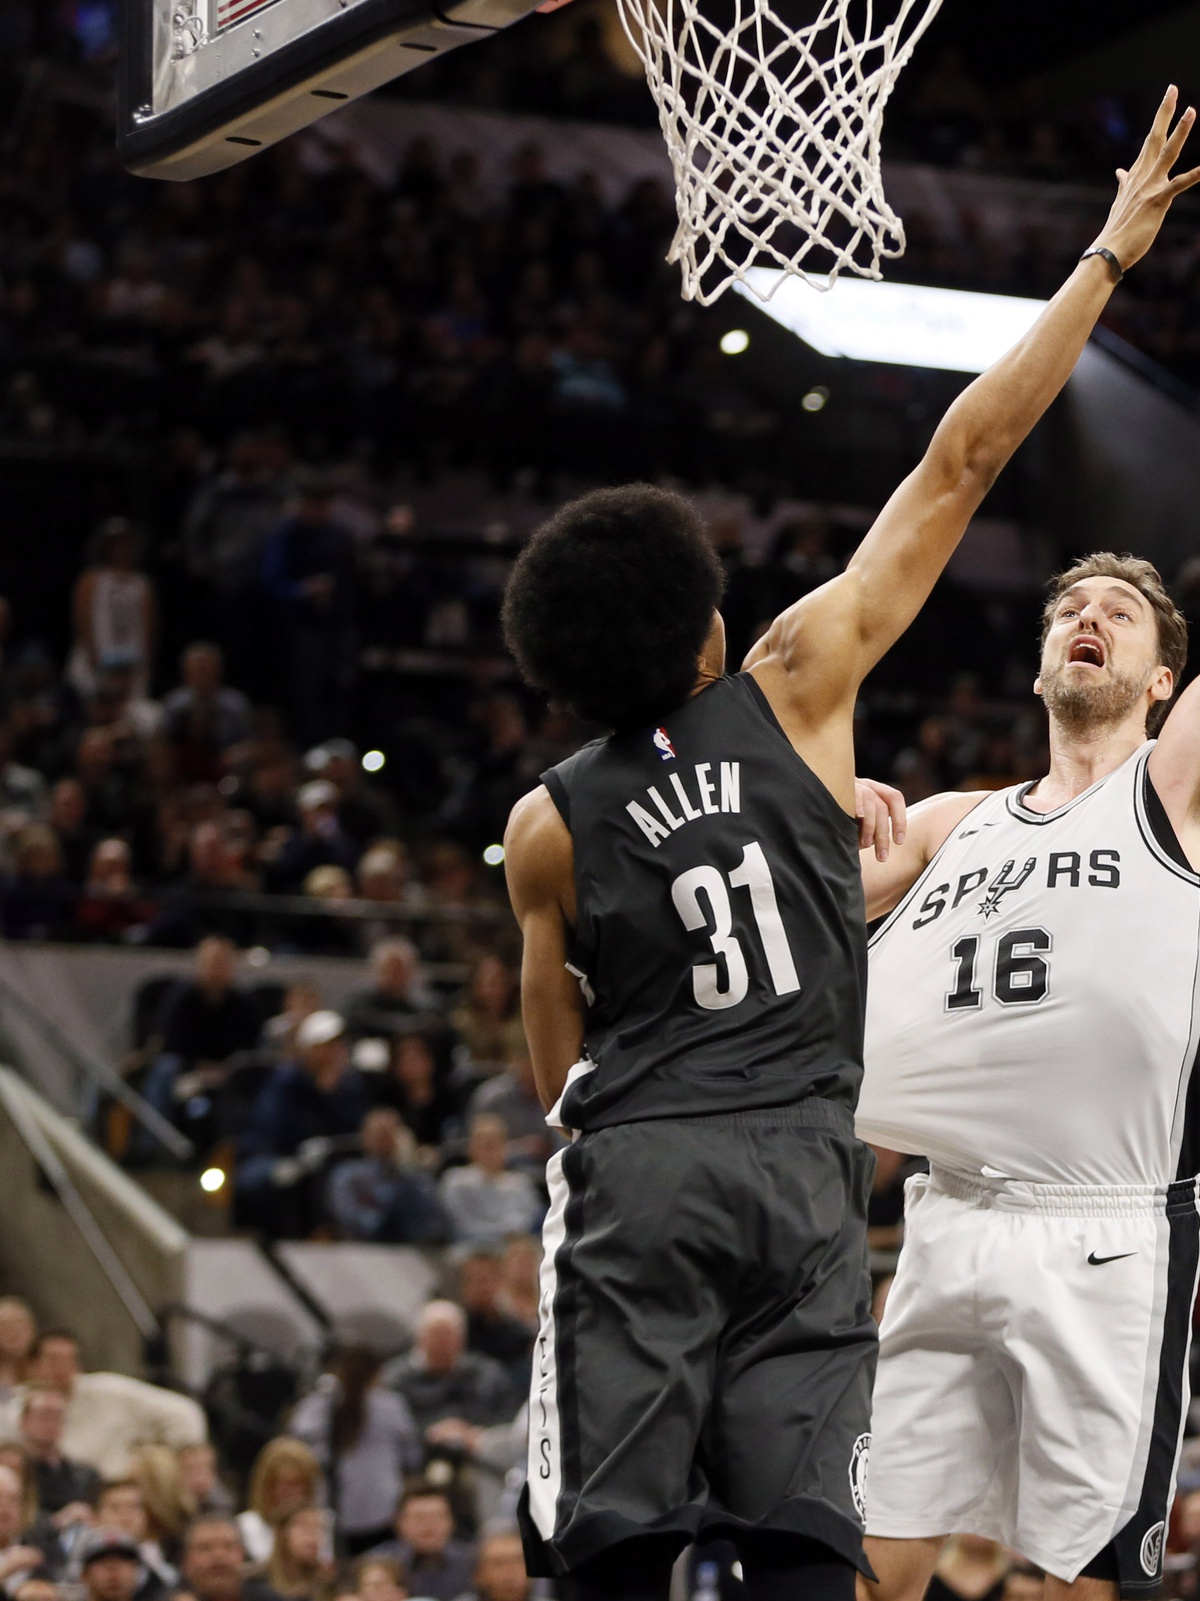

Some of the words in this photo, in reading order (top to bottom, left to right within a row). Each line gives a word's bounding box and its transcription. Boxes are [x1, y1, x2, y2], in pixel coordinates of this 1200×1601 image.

[626, 762, 740, 848] ALLEN
[671, 841, 801, 1009] 31
[912, 850, 1120, 930] SPURS
[944, 926, 1053, 1013] 16
